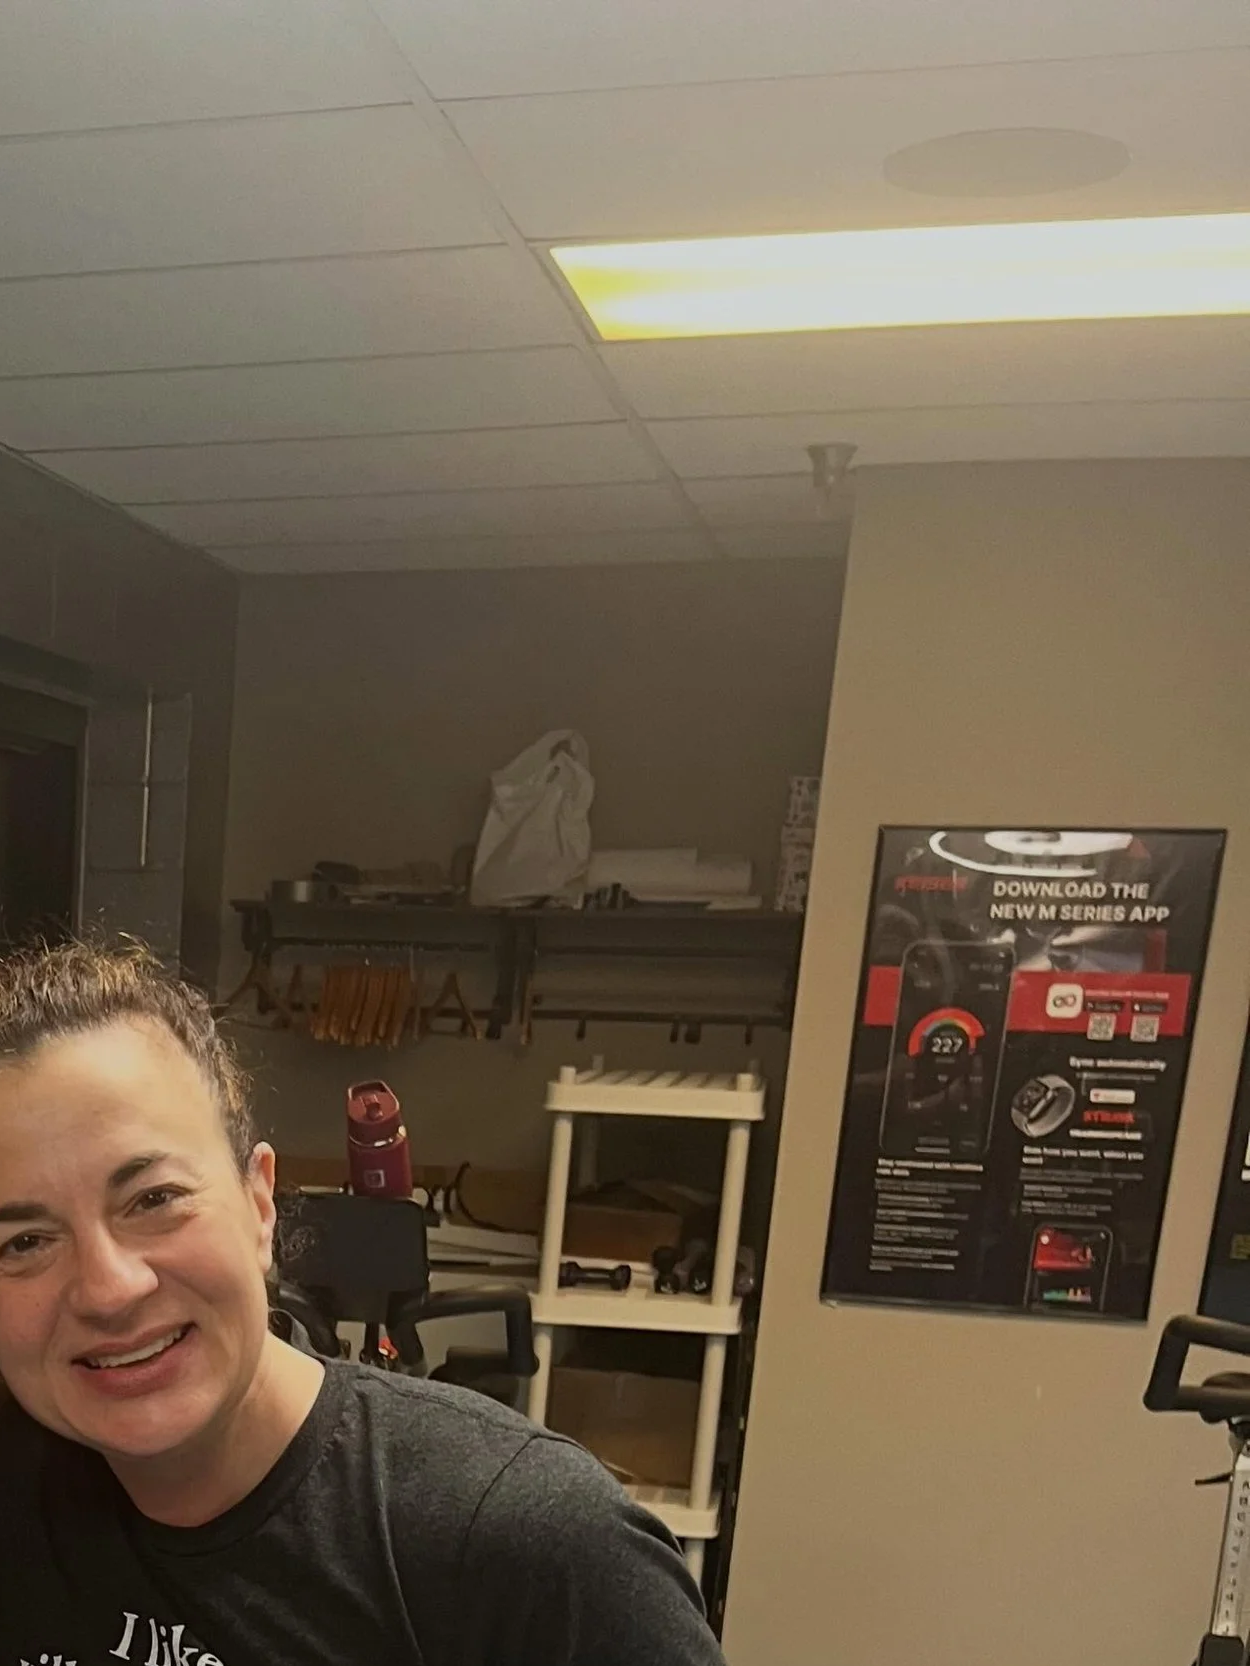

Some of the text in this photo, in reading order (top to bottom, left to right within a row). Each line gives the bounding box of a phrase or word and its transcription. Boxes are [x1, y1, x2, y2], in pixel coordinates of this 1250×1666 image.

[992, 880, 1149, 901] DOWNLOAD THE
[989, 903, 1170, 923] NEW M SERIES APP
[109, 1611, 138, 1660] I
